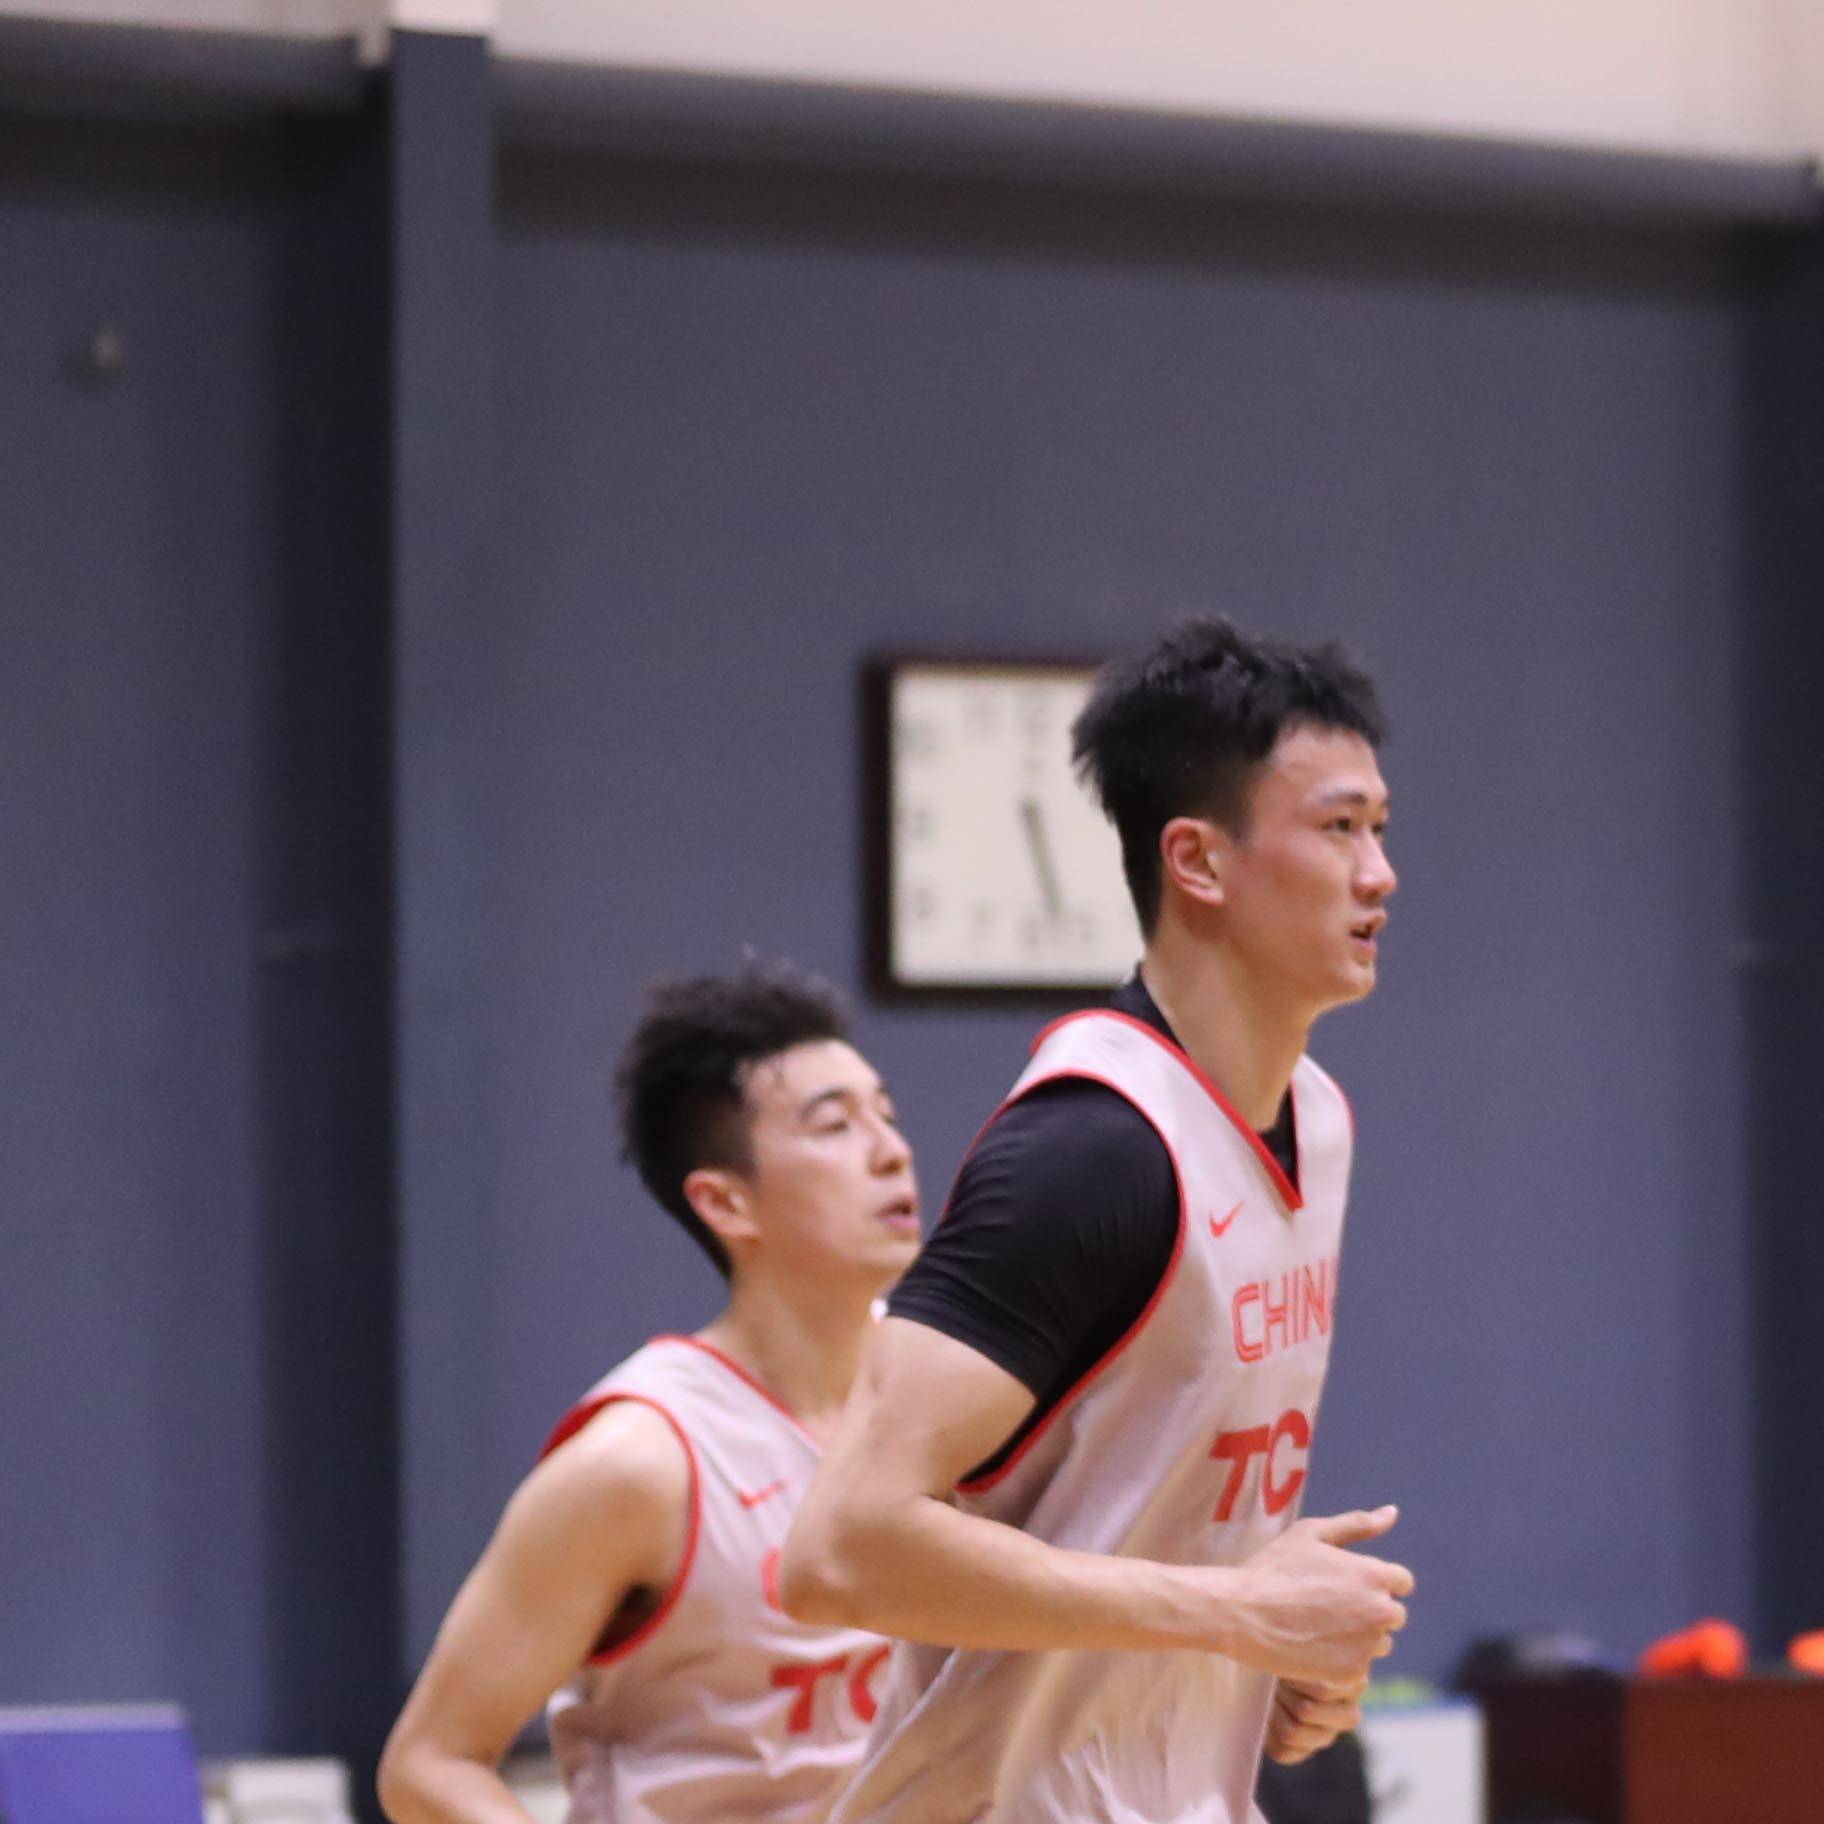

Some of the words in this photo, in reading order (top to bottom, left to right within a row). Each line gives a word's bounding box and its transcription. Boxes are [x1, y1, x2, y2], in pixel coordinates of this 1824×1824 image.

[1232, 1256, 1338, 1364] CHIN
[1210, 1409, 1310, 1523] TC
[770, 1644, 891, 1734] TC
